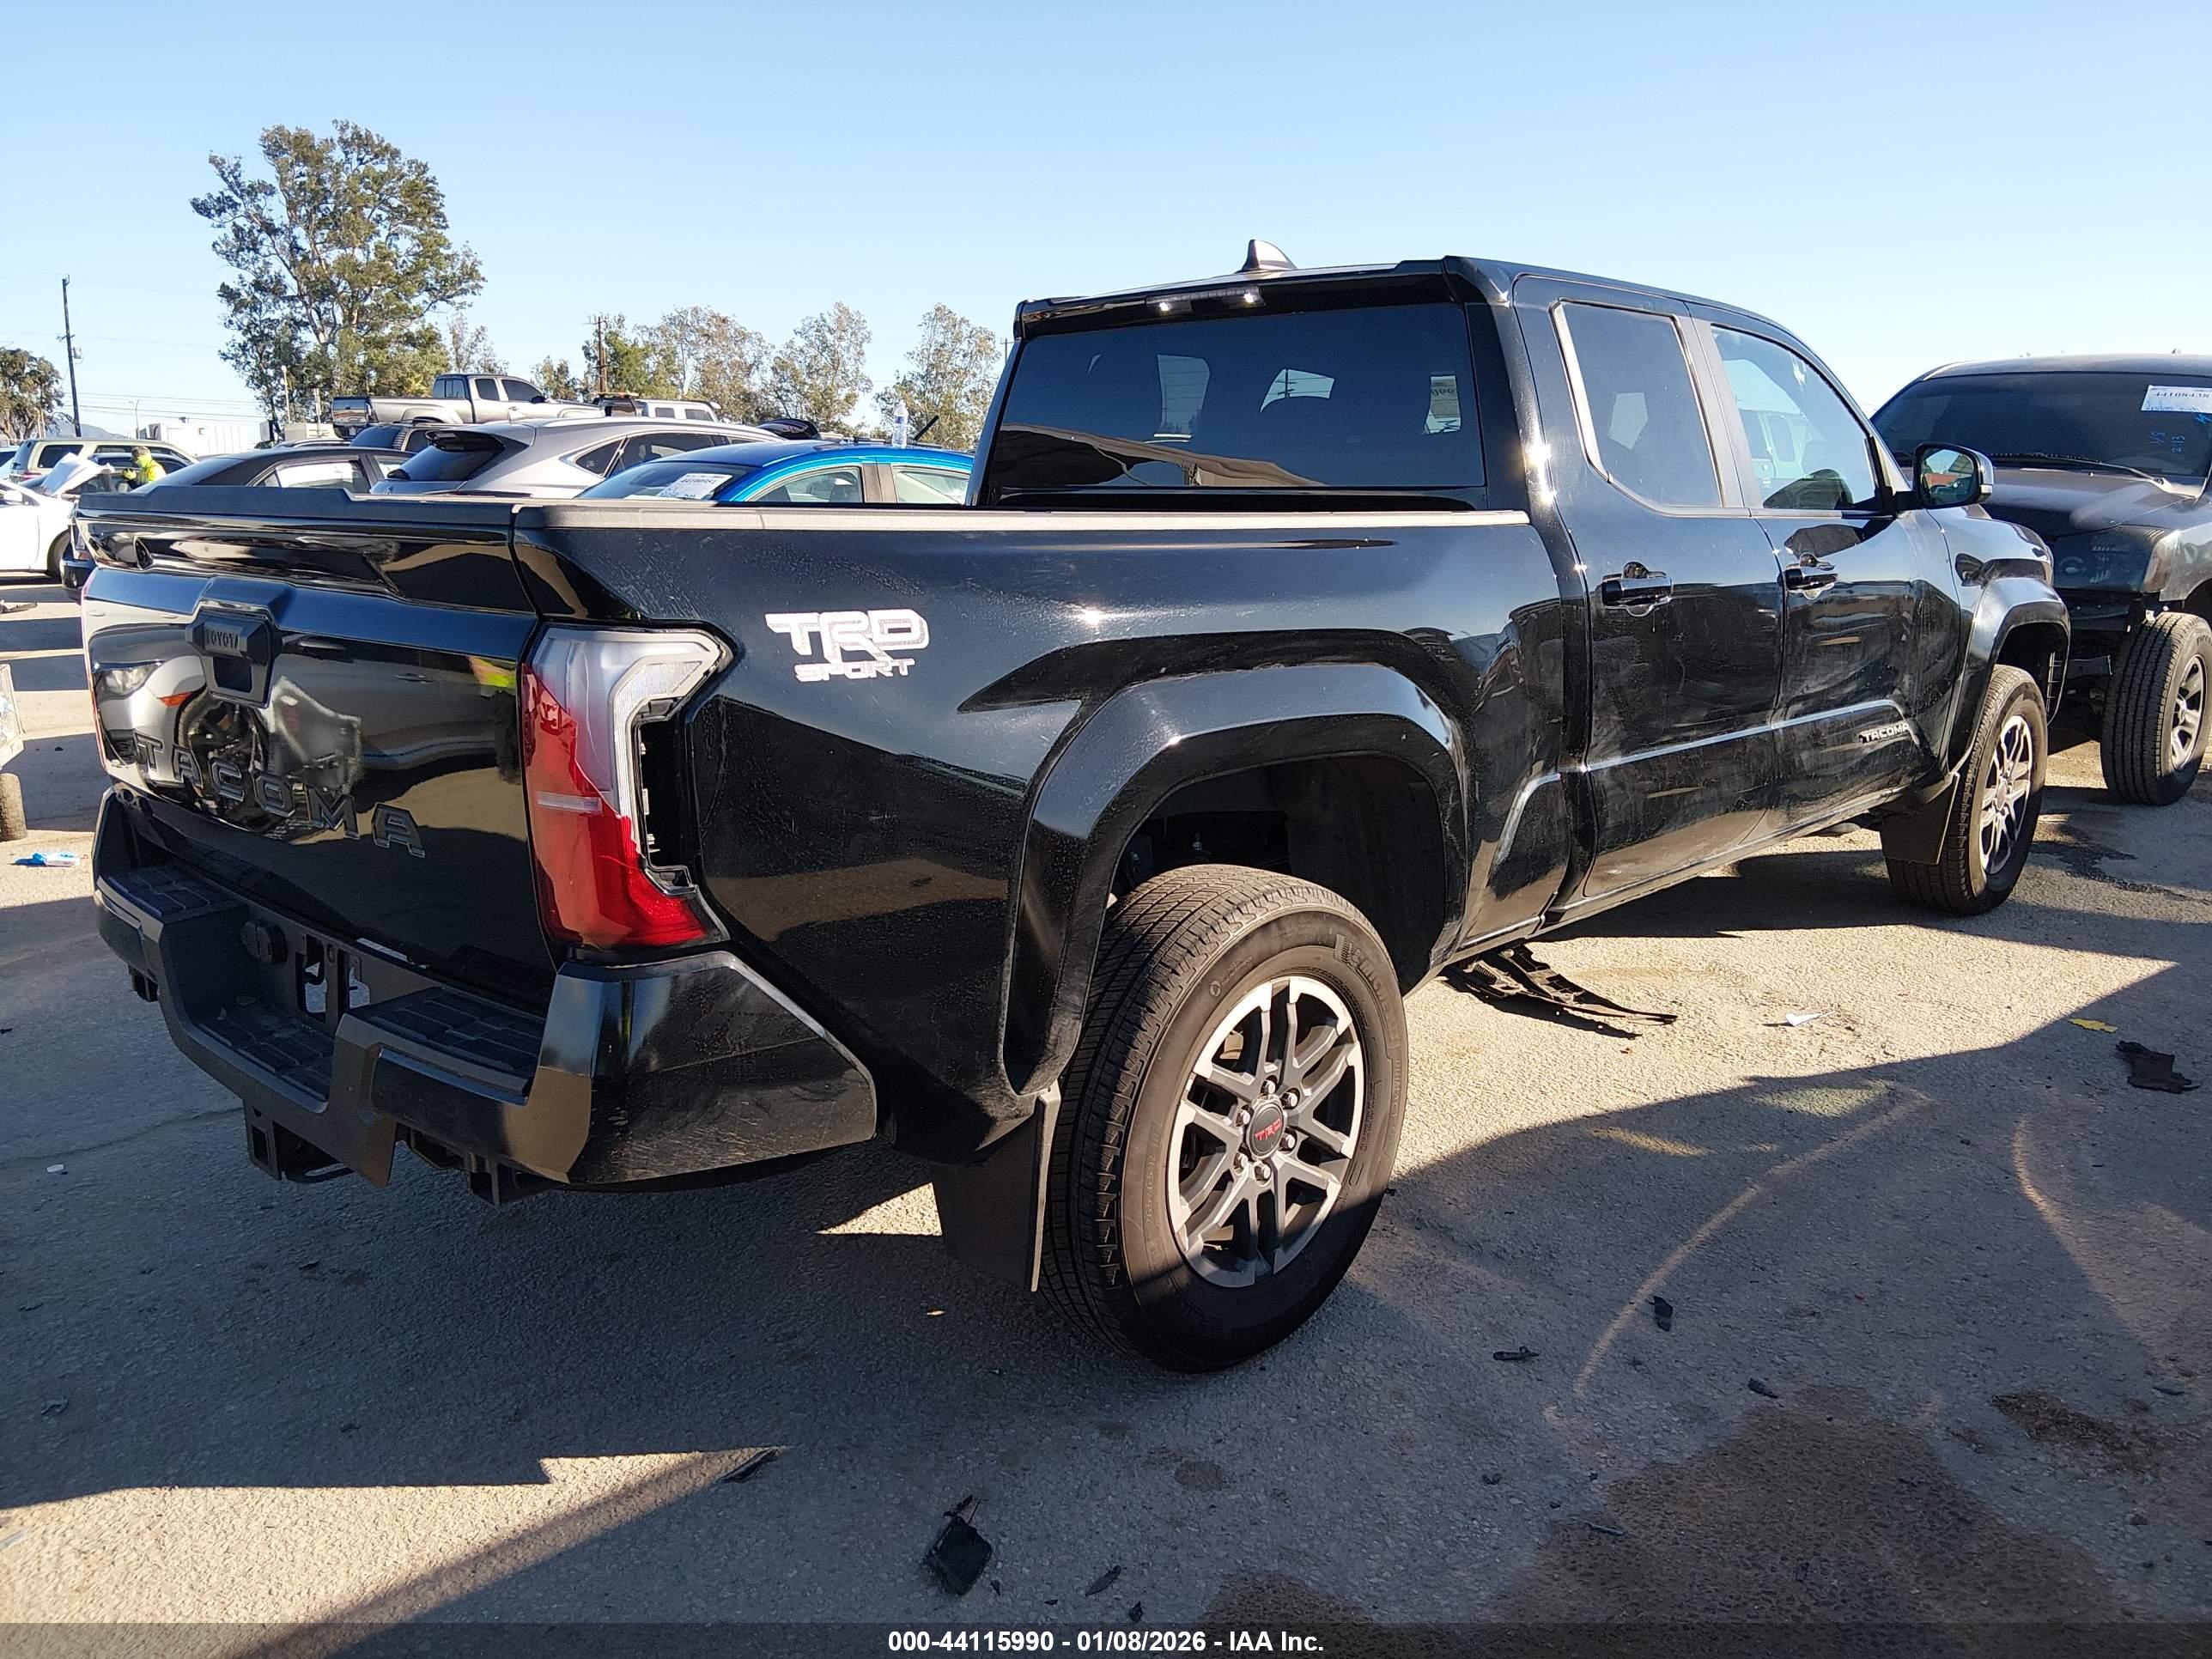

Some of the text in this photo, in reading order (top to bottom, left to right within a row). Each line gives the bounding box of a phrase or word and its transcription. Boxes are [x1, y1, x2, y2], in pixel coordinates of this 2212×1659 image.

[765, 608, 930, 660] TRD
[794, 658, 915, 683] SPORT
[1861, 722, 1911, 743] TACOMA
[133, 728, 425, 859] TACOMA
[1255, 1118, 1280, 1141] TRD
